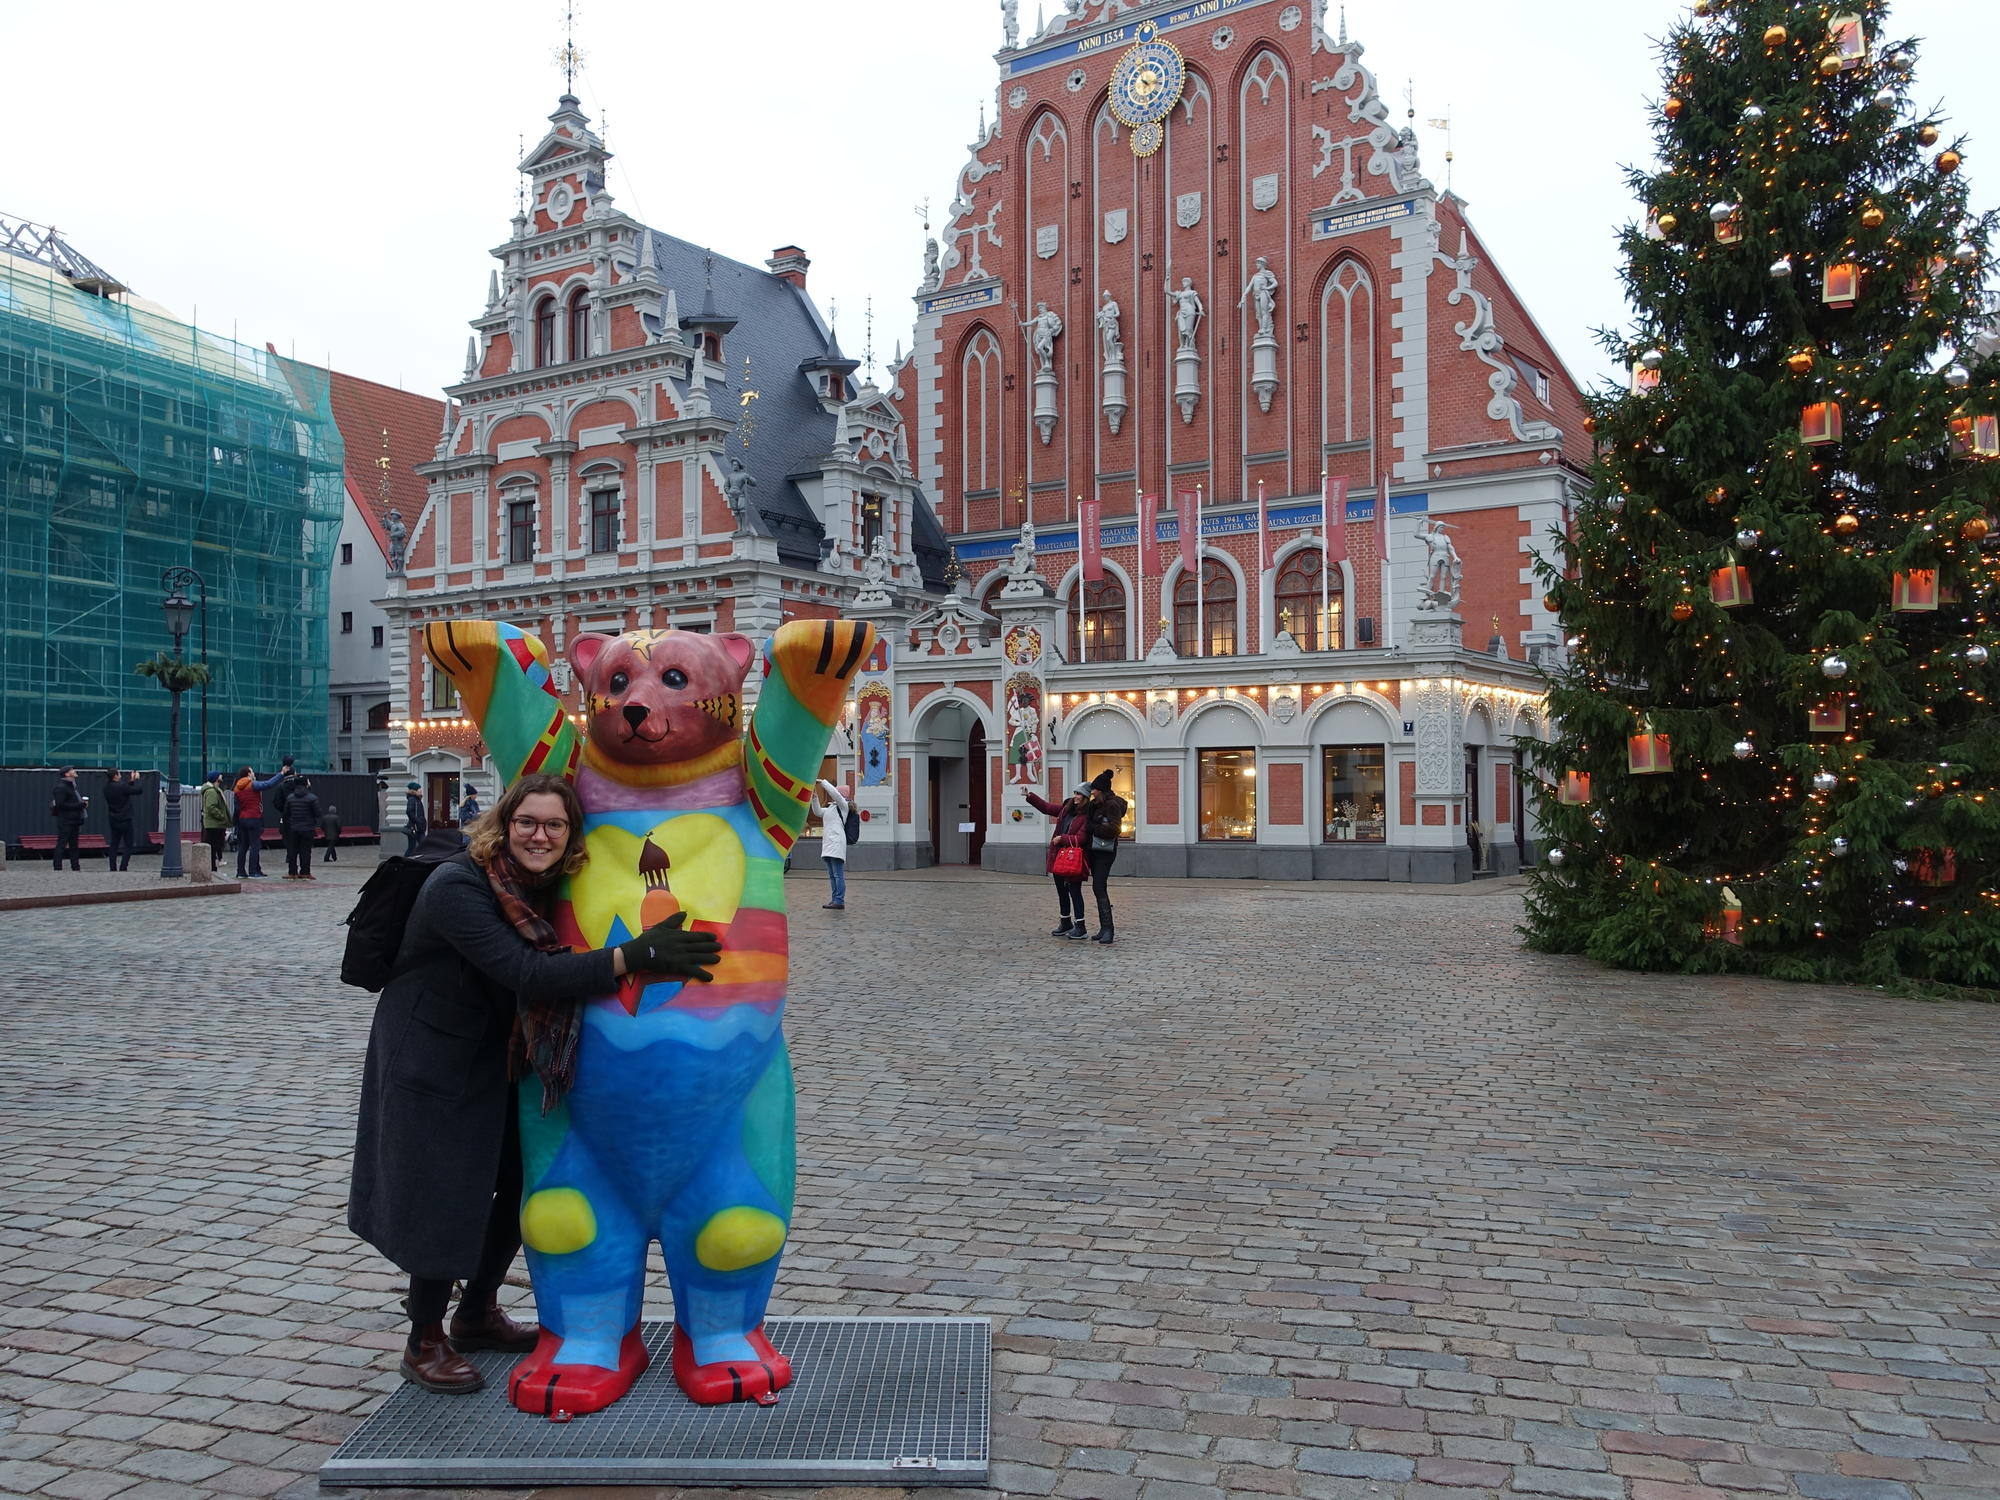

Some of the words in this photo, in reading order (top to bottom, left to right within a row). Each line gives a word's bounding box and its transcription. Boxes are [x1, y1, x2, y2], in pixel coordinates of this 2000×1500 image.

[1078, 36, 1101, 52] ANNO
[1104, 28, 1124, 44] 1334
[1193, 0, 1219, 17] ANNO
[1159, 523, 1177, 531] TIKA
[1203, 523, 1244, 533] PAMATIEM
[1268, 518, 1291, 527] AUNA
